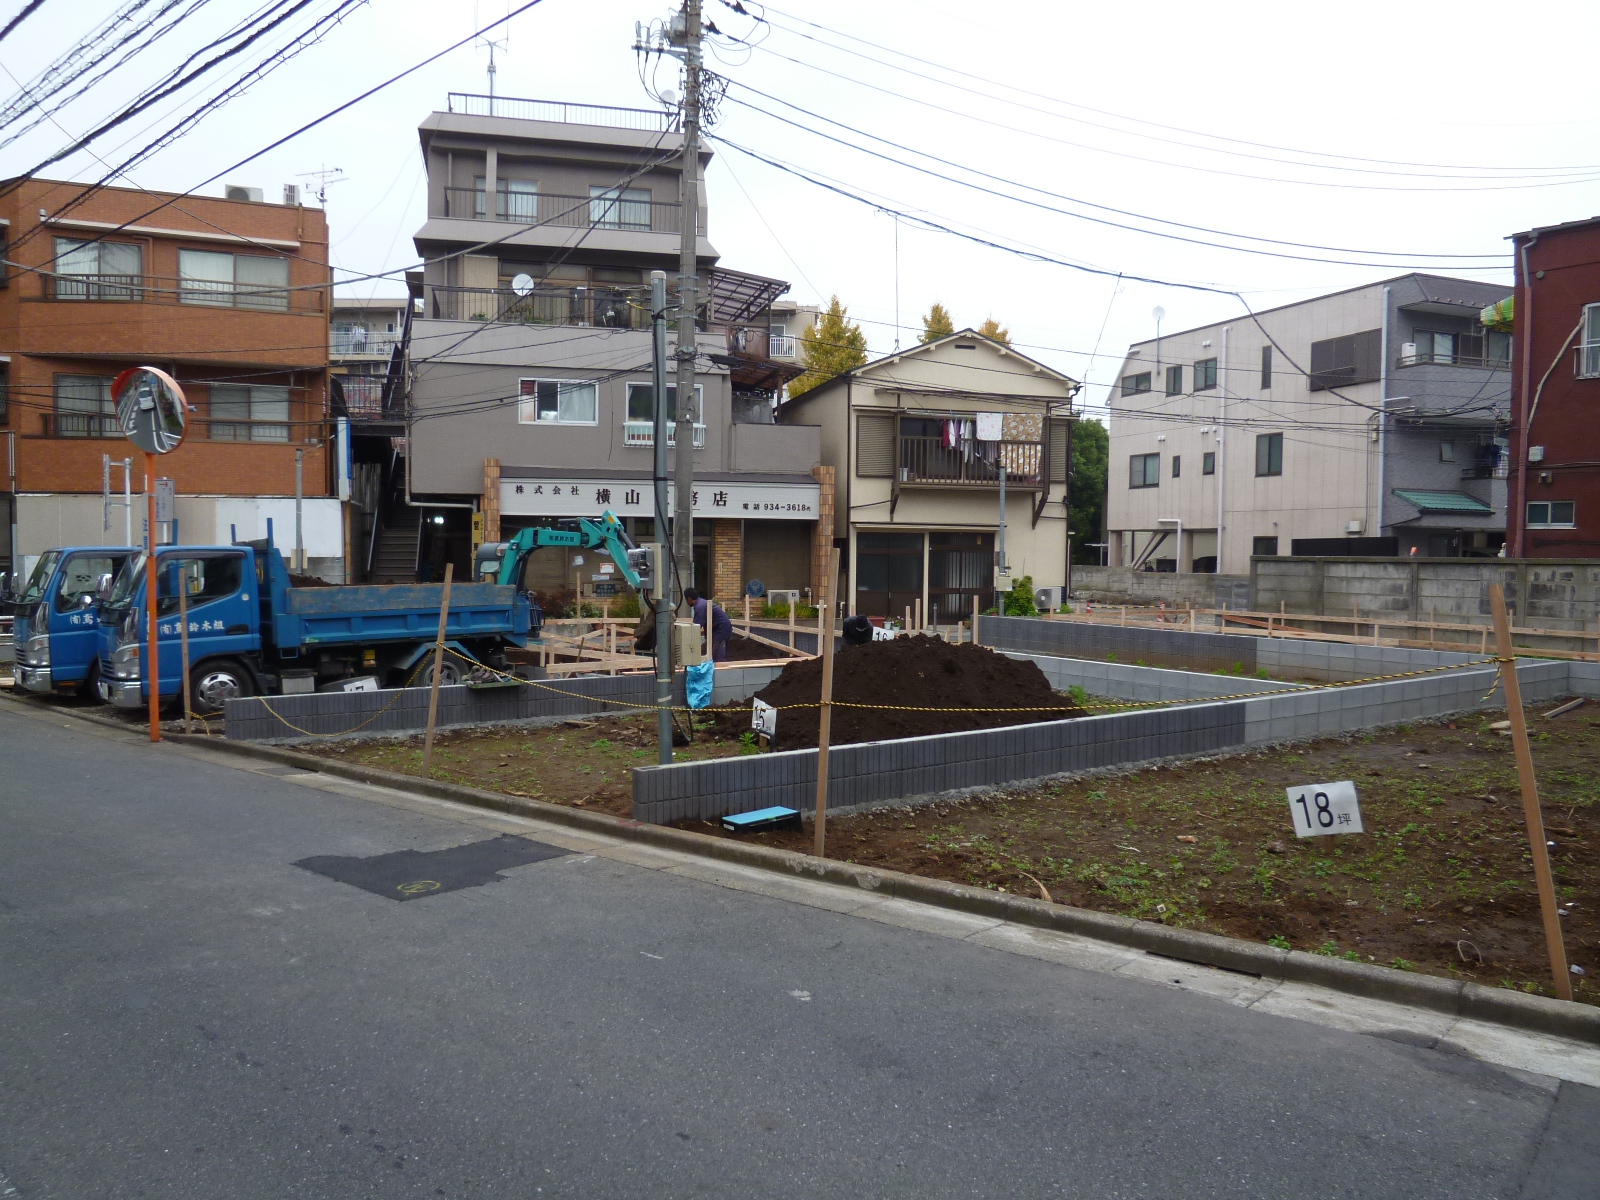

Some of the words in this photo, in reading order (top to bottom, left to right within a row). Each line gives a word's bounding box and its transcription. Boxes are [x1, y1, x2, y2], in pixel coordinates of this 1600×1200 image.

[515, 484, 580, 496] 株式会社
[595, 488, 728, 507] 横山店
[742, 502, 760, 511] 電話
